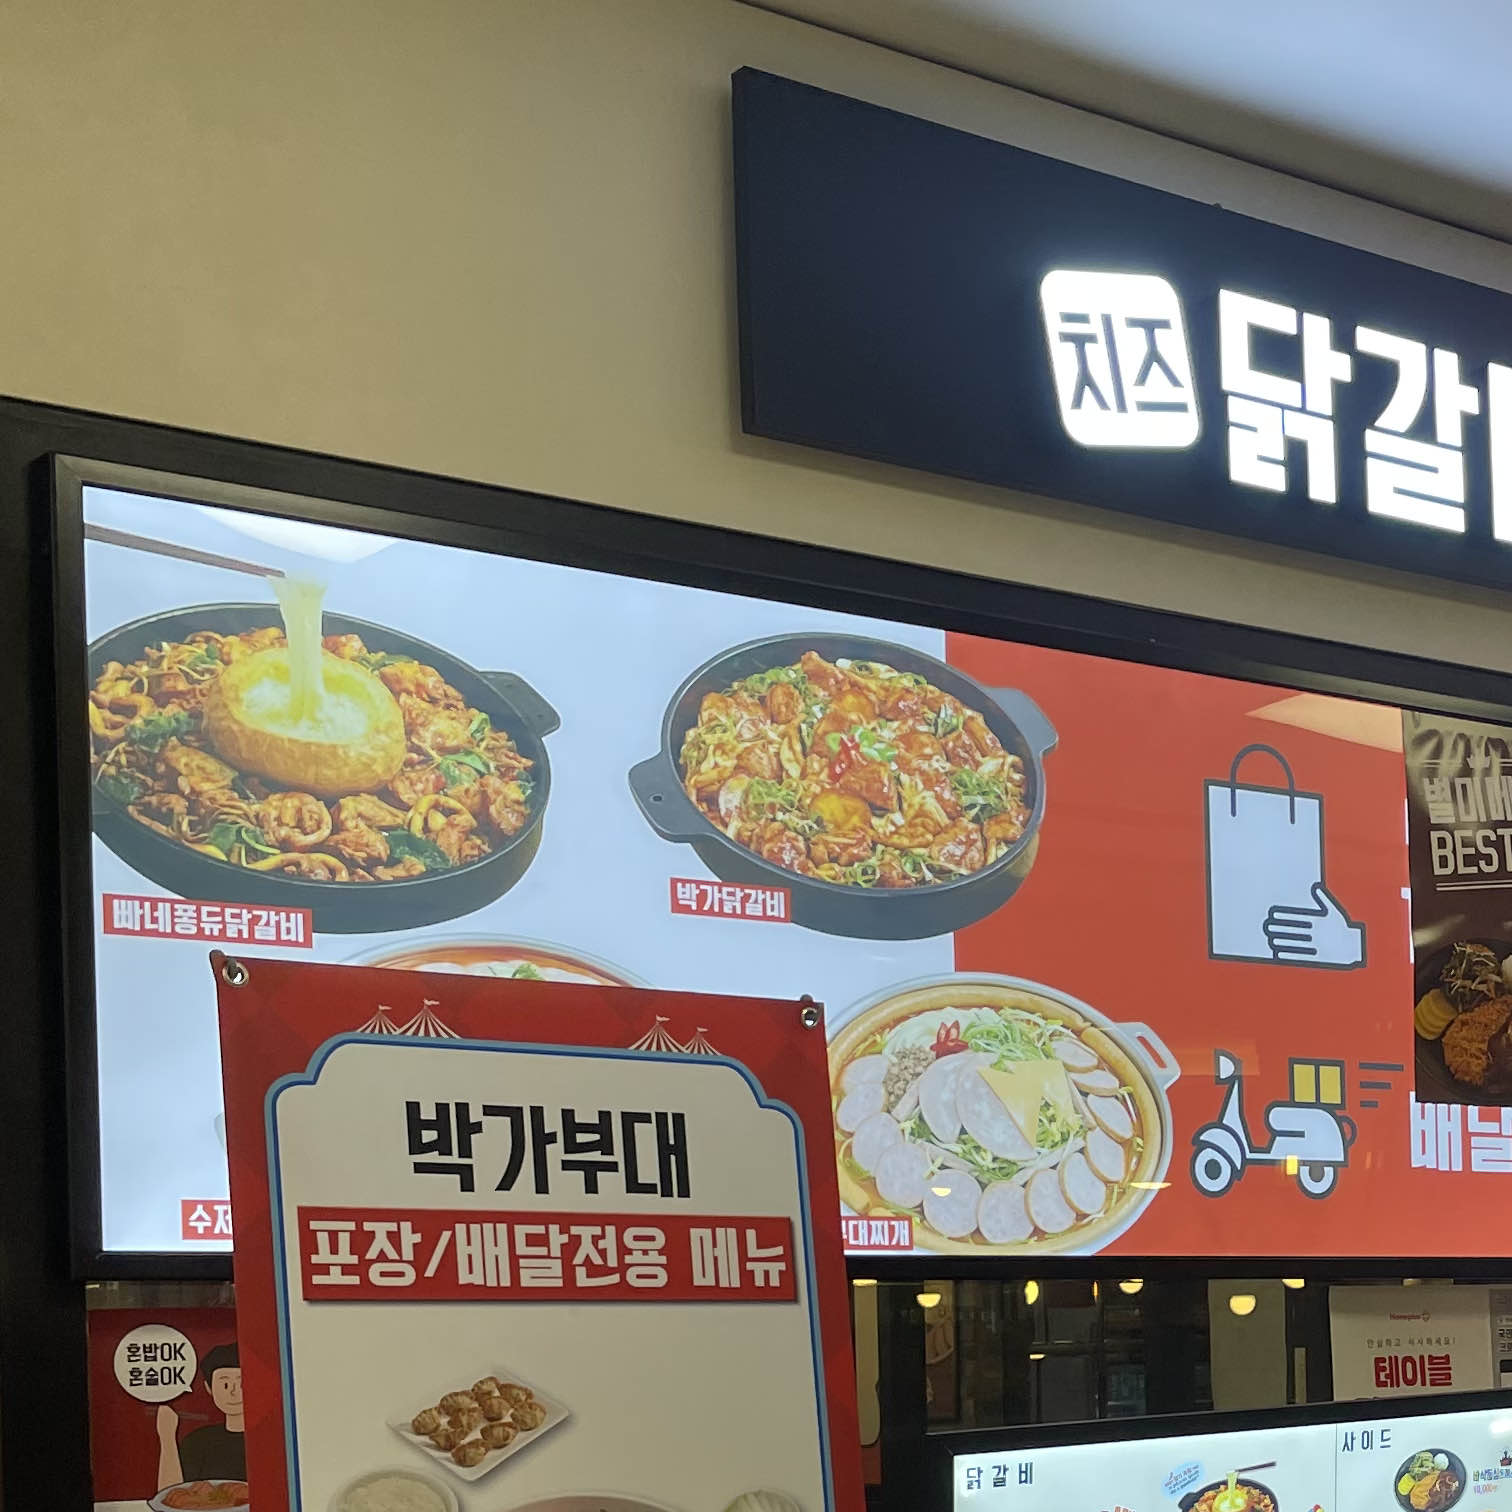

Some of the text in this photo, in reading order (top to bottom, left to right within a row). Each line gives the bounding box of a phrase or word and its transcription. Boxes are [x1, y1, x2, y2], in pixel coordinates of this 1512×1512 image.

[1059, 310, 1189, 414] 치즈
[112, 898, 305, 943] 빠네퐁듀닭갈비
[676, 881, 786, 919] 박가닭갈비
[404, 1100, 692, 1200] 박가부대
[308, 1218, 788, 1290] 포장/배달전용 메뉴
[125, 1341, 187, 1364] 혼밥OK
[1373, 1353, 1453, 1389] 테이블
[128, 1365, 187, 1387] 혼술OK
